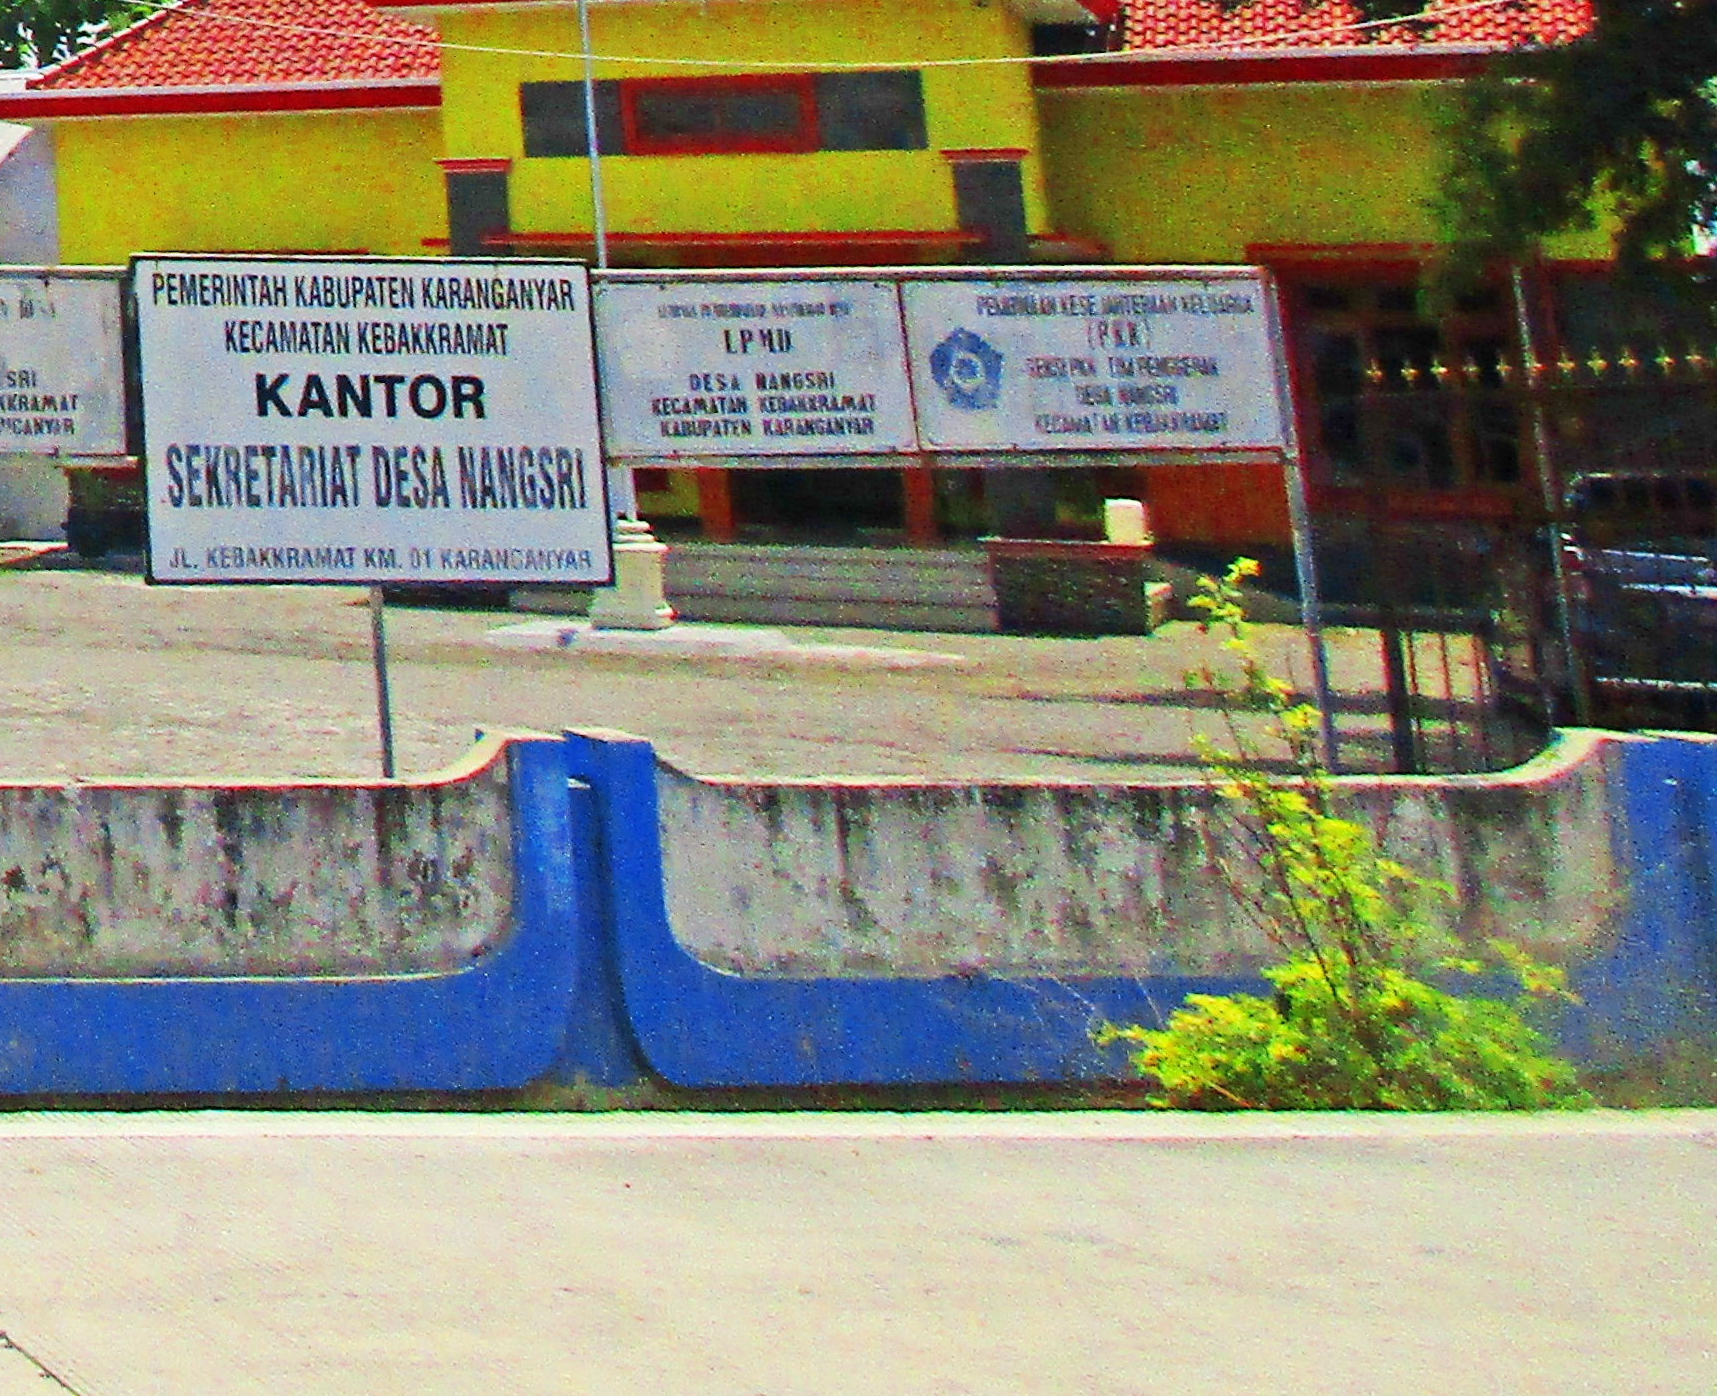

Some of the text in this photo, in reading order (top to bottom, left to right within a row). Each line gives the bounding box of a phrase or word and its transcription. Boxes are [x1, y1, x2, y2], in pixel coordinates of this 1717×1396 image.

[152, 274, 575, 311] PEMERINTAH KABUPATEN KARANGANYAR
[225, 321, 508, 356] KECAMATAN KEBAKKRAMAT
[255, 373, 487, 419] KANTOR
[689, 372, 835, 392] DESA NANGSRI
[652, 396, 748, 415] KECAMATAN
[660, 418, 875, 437] KABUPATEN KARANGANYAR
[165, 443, 587, 510] SEKRETARIAT DESA NANGSRI
[169, 548, 199, 569] JL.
[207, 547, 357, 569] KEBAKKRAMAT
[364, 548, 403, 570] KM.
[442, 549, 591, 571] KARANGANYAR
